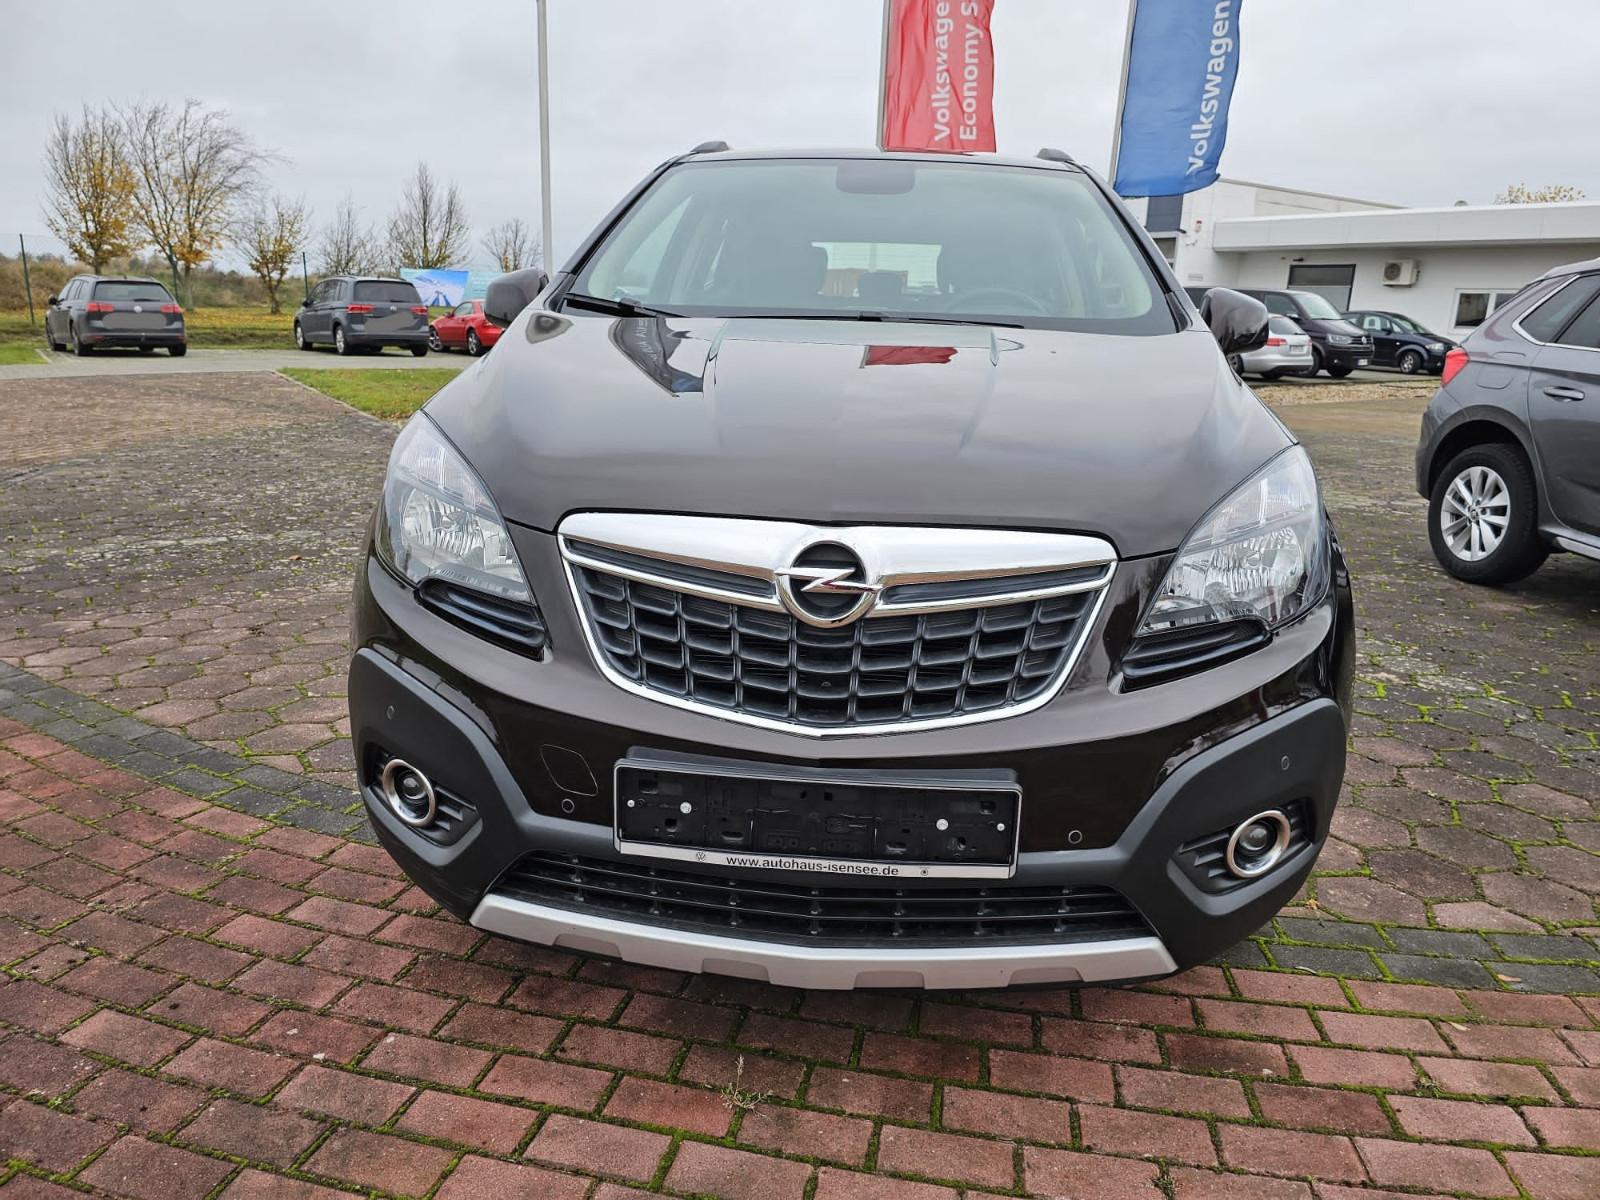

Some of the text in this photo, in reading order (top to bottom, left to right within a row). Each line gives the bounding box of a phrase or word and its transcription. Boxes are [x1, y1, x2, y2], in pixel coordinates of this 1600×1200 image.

[931, 0, 953, 141] Volkswage
[960, 23, 982, 141] Economy
[1186, 0, 1233, 174] Volkswagen
[726, 855, 899, 876] www.autohaus-isensee.de
